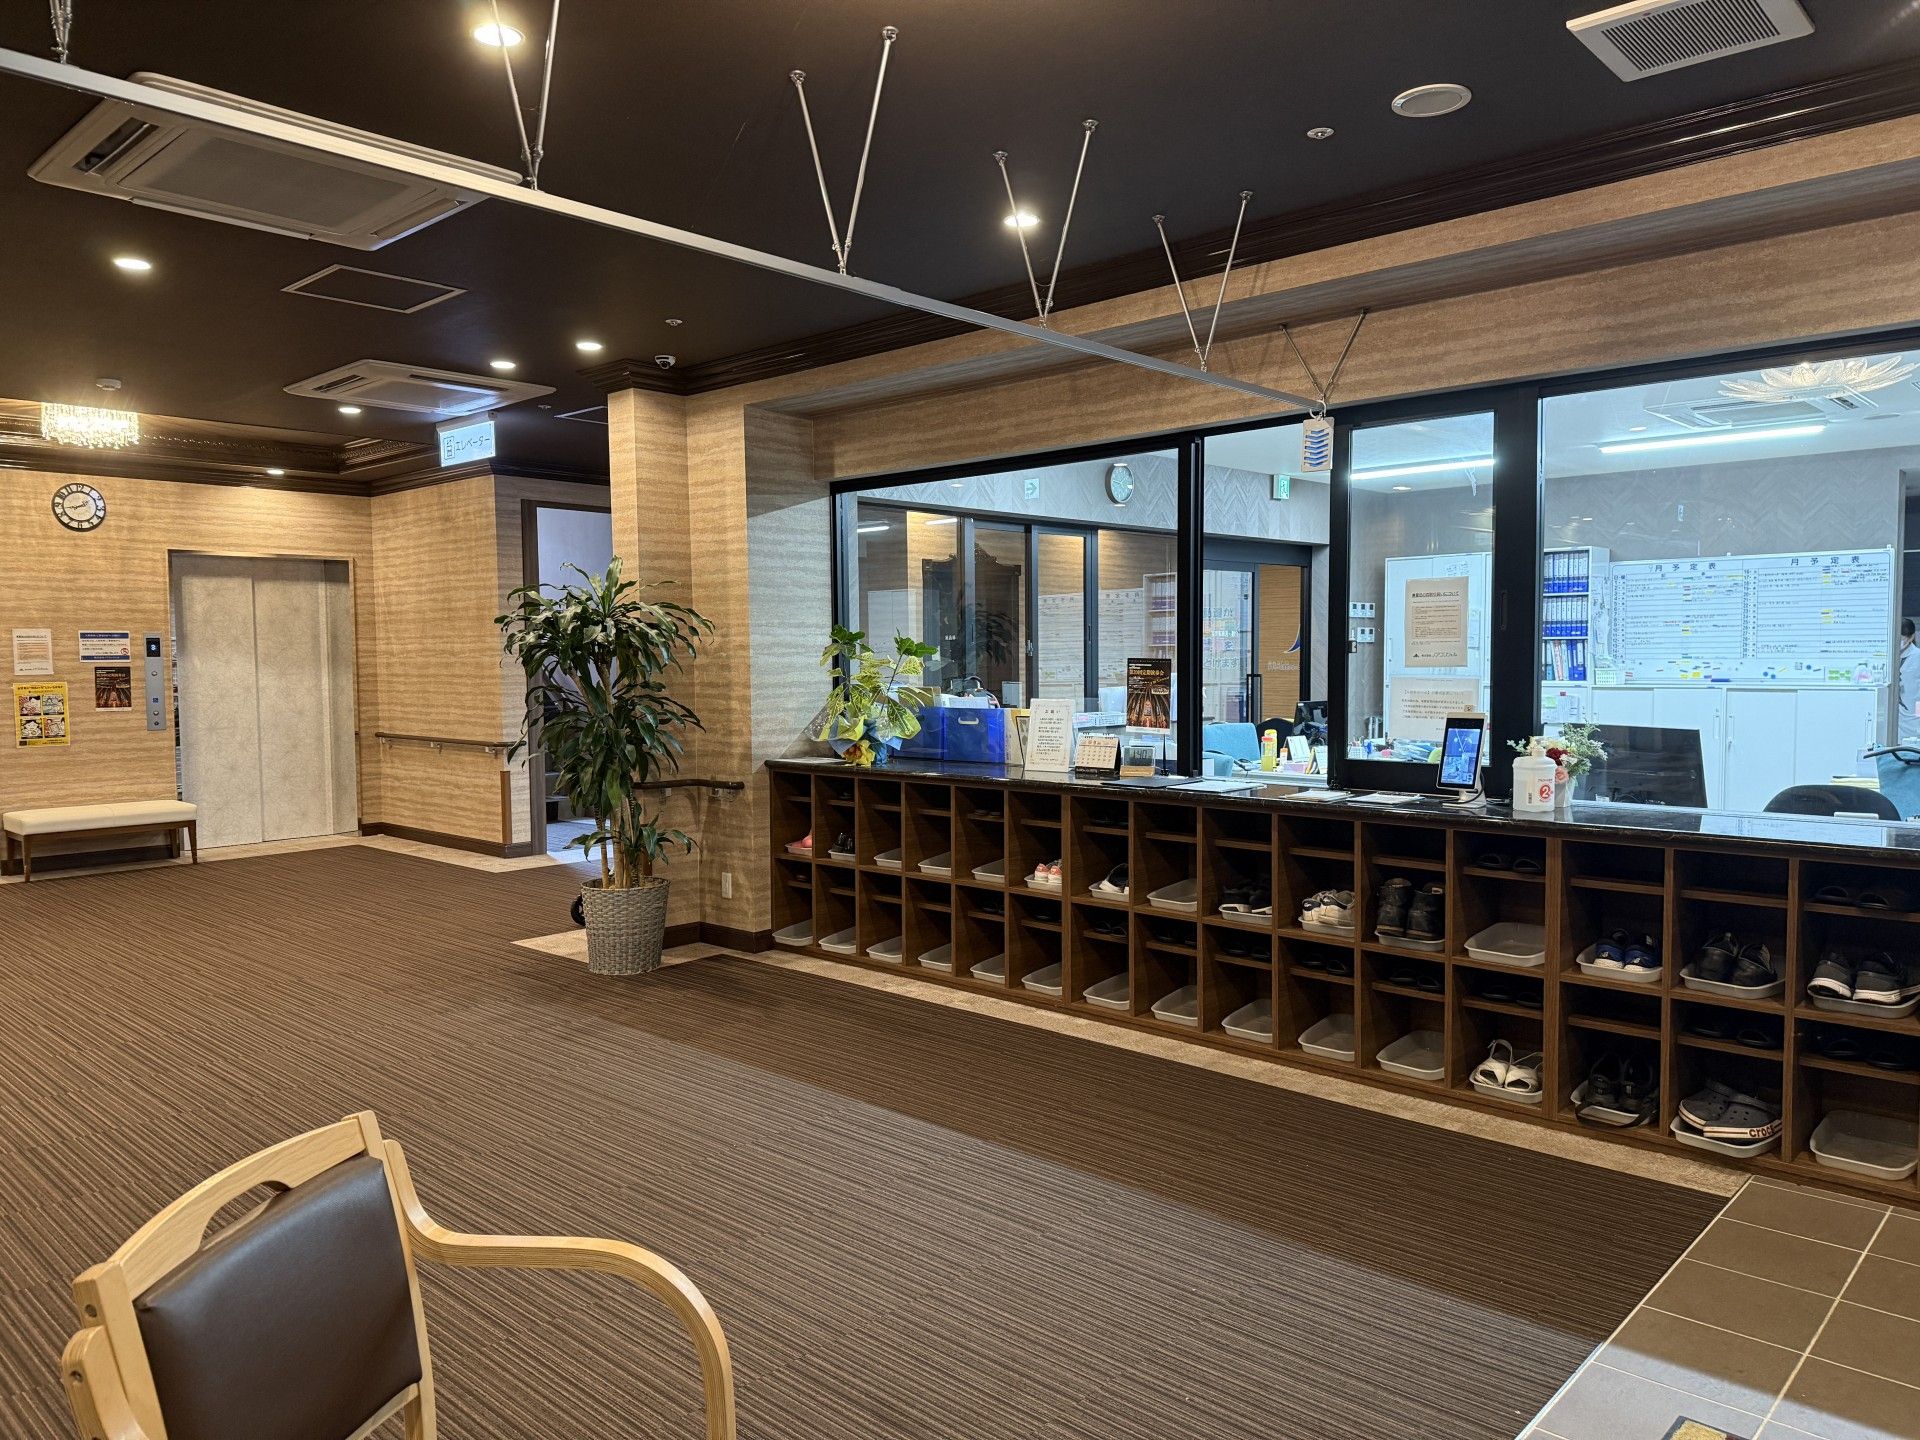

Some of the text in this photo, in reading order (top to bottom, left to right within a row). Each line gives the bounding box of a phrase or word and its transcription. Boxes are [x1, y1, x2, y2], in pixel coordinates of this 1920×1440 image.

[455, 435, 490, 451] エレベーター
[1541, 786, 1549, 798] 2
